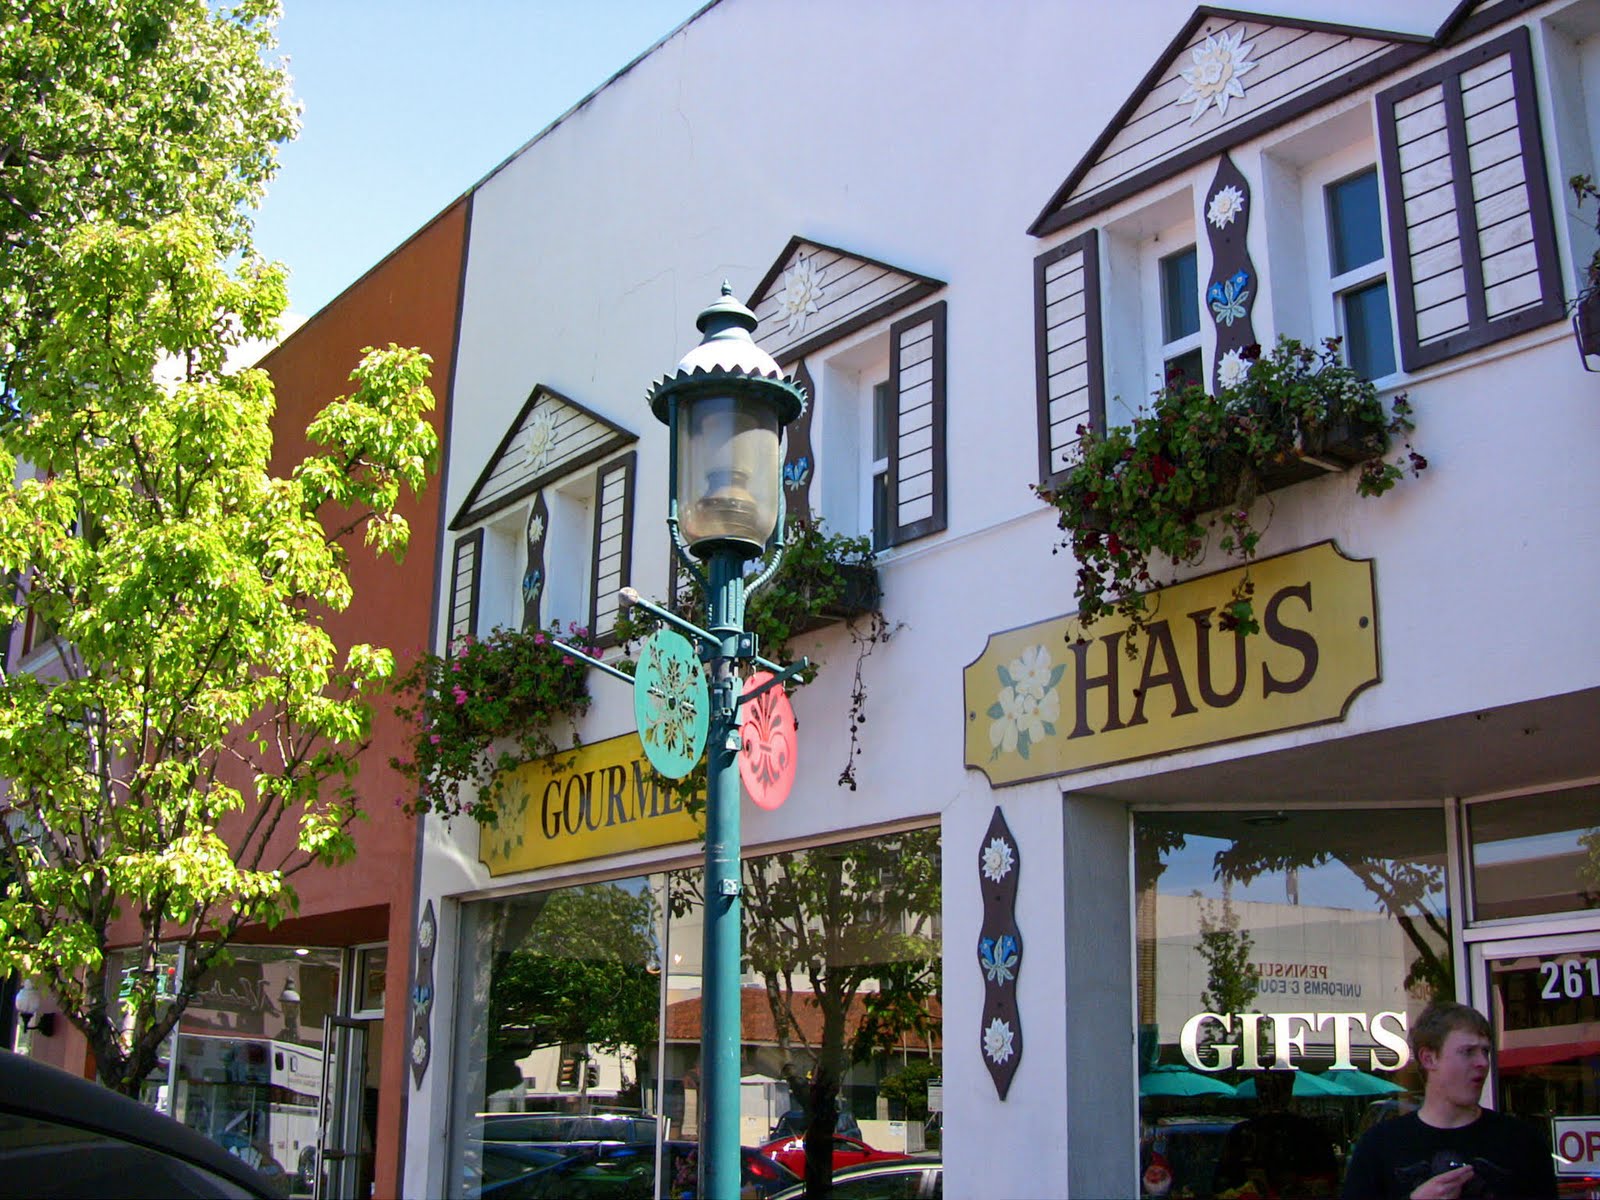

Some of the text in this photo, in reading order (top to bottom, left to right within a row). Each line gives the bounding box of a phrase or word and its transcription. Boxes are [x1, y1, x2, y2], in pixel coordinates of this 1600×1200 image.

[1067, 581, 1319, 740] HAUS
[1540, 958, 1600, 999] 261
[1180, 1011, 1411, 1072] GIFTS
